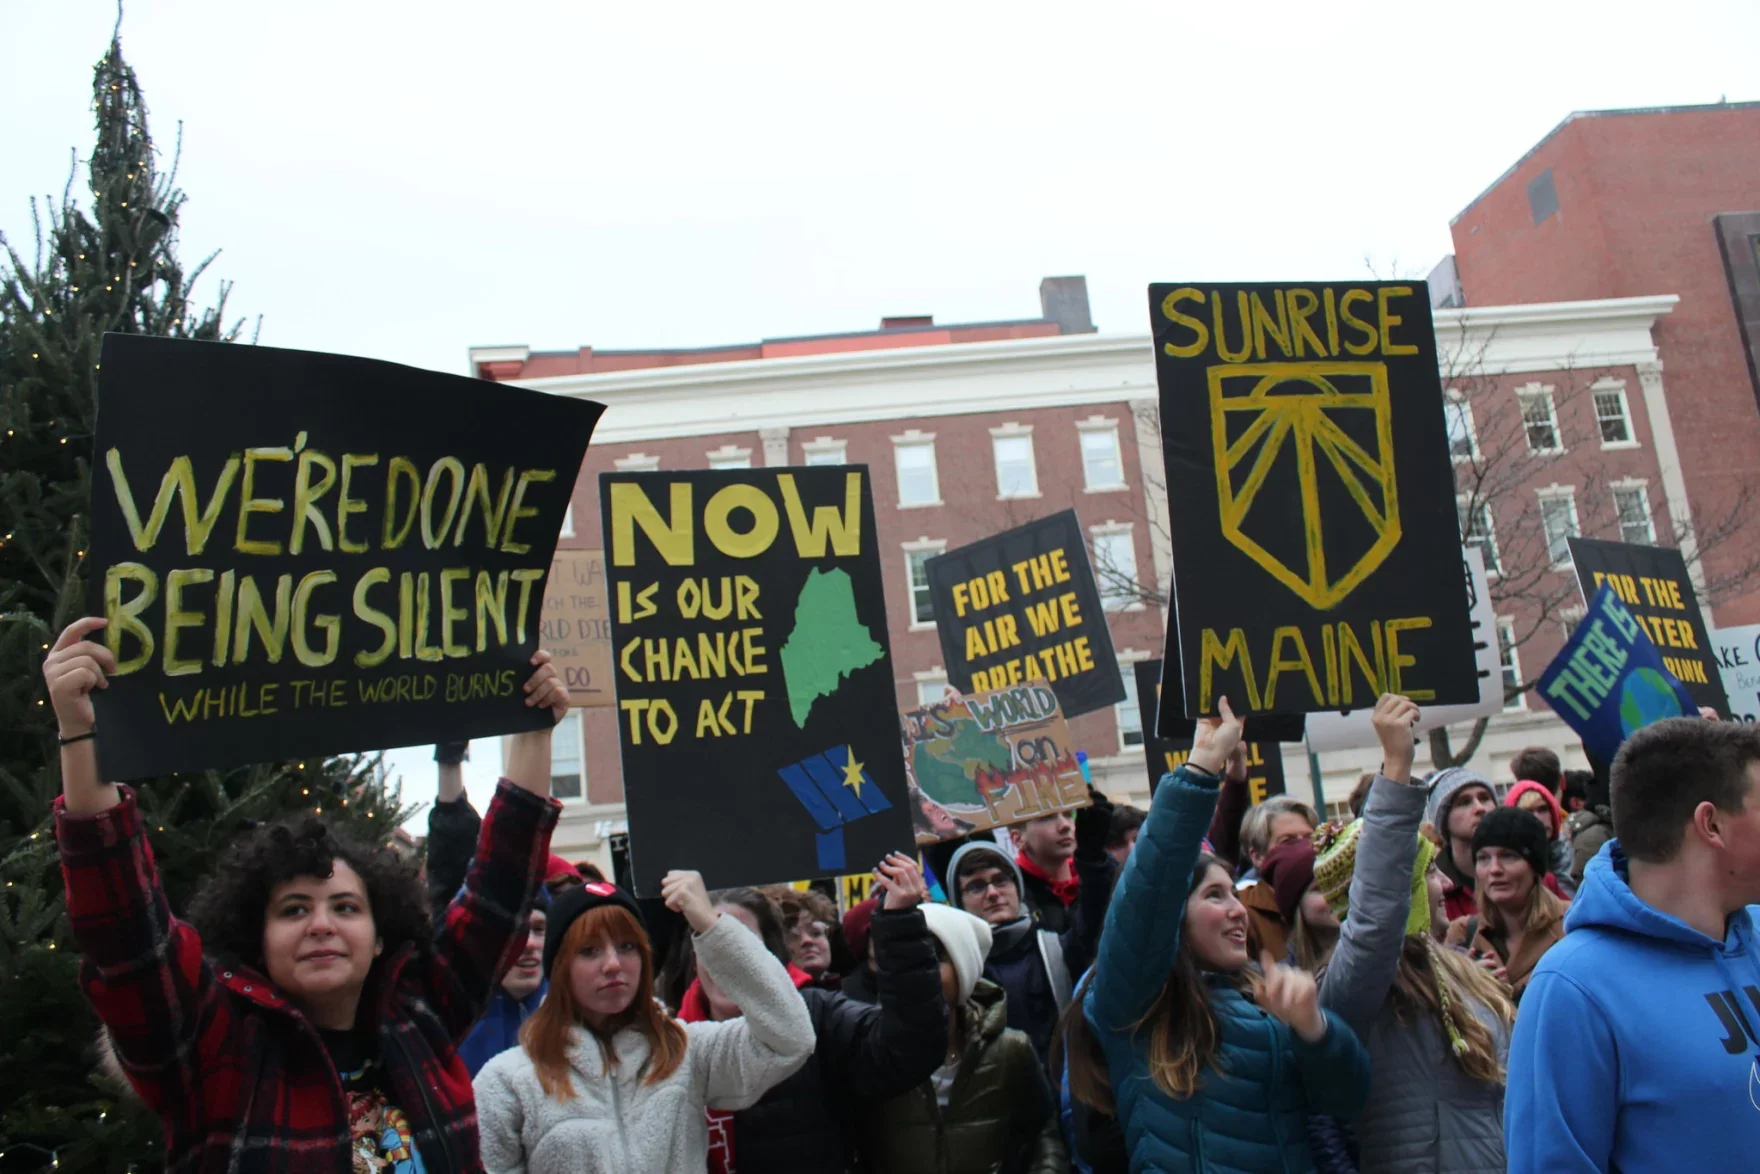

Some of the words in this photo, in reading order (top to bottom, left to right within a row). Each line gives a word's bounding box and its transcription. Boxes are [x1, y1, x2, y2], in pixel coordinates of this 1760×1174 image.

[1161, 286, 1418, 362] SUNRISE
[106, 431, 378, 555] WE'RE
[381, 455, 557, 554] DONE
[610, 473, 862, 566] NOW
[618, 580, 660, 624] IS
[677, 575, 763, 620] OUR
[952, 569, 1009, 618] FOR
[1012, 548, 1071, 596] THE
[1639, 576, 1685, 610] THE
[103, 561, 341, 677] BEING
[352, 566, 545, 669] SILENT
[965, 613, 1021, 662] AIR
[1025, 592, 1083, 638] WE
[564, 666, 591, 688] DO
[621, 627, 768, 683] CHANCE
[1201, 616, 1435, 714] MAINE
[1547, 617, 1629, 721] THERE
[1601, 589, 1639, 645] IS
[158, 683, 279, 725] WHILE
[290, 680, 348, 709] THE
[358, 675, 438, 703] WORLD
[445, 669, 516, 702] BURNS
[621, 698, 679, 745] TO
[696, 690, 765, 738] ACT
[965, 687, 1060, 733] WORLD
[985, 770, 1088, 825] FIRE
